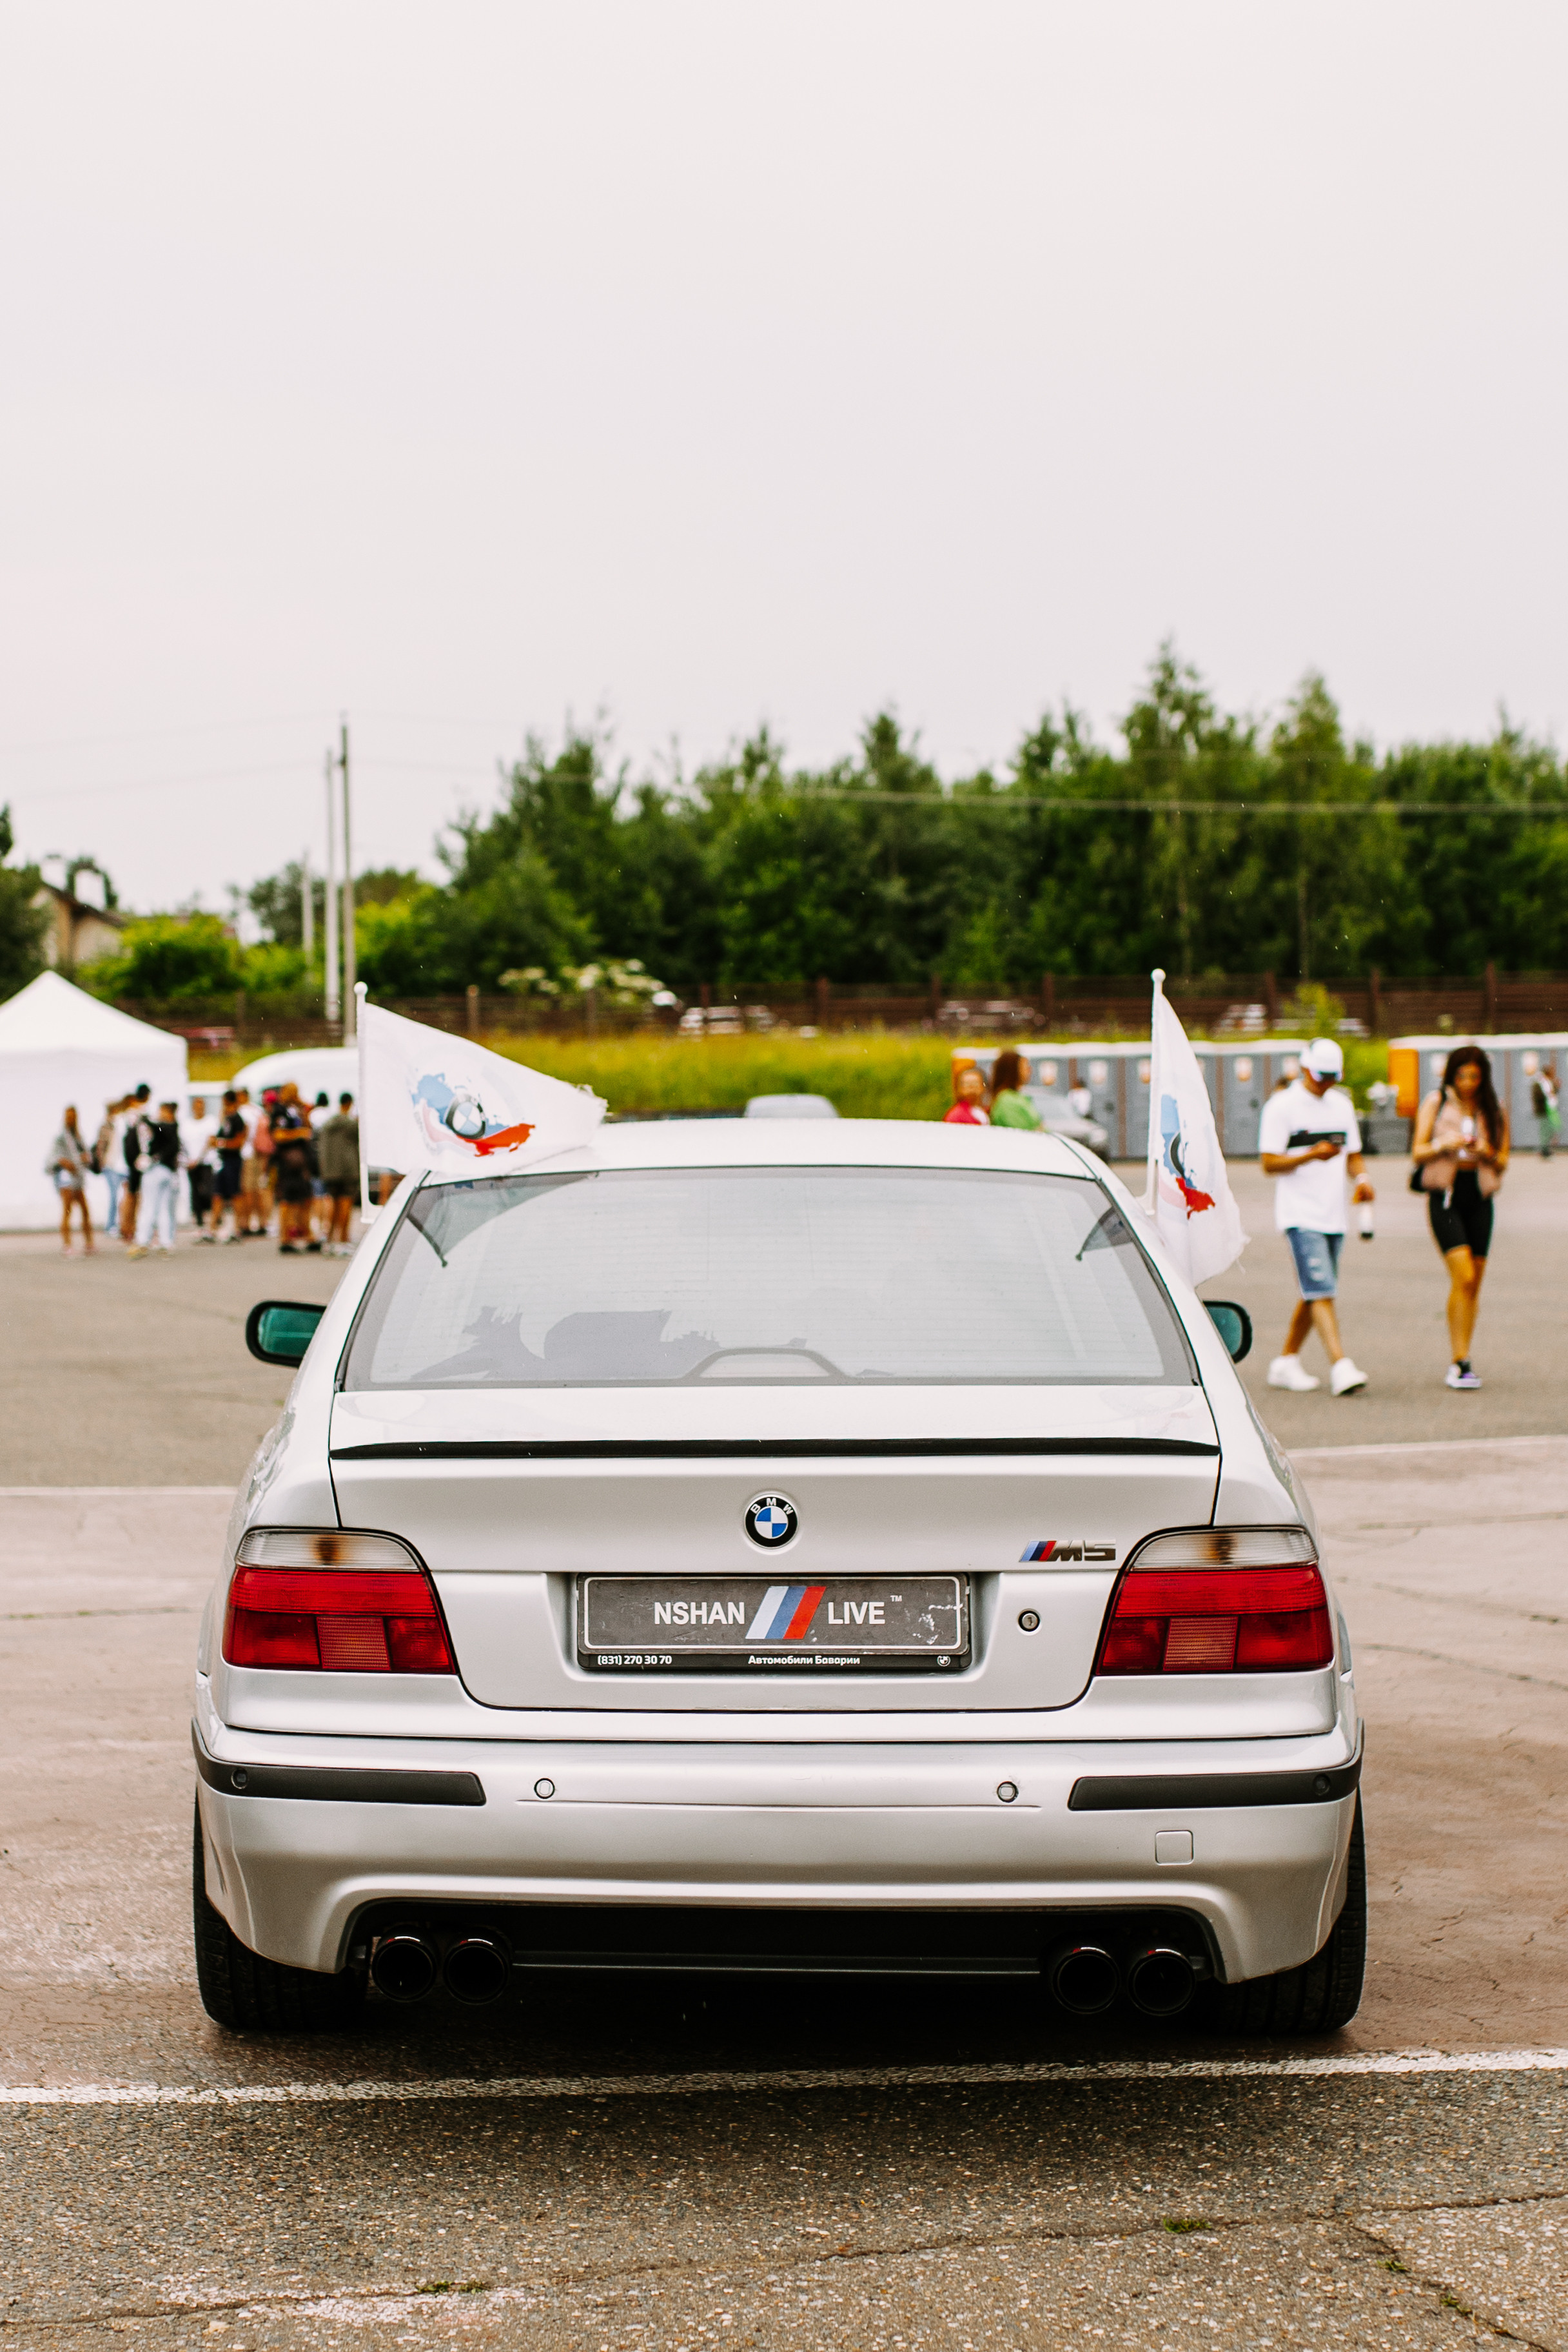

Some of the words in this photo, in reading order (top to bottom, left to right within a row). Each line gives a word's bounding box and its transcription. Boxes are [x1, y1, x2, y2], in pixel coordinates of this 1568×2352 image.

[750, 1497, 794, 1515] BMW
[1047, 1540, 1116, 1562] M5
[654, 1602, 745, 1625] NSHAN
[828, 1602, 885, 1625] LIVE
[597, 1654, 622, 1665] (831)
[623, 1655, 643, 1665] 270
[644, 1655, 658, 1665] 30
[658, 1655, 672, 1665] 70
[748, 1655, 814, 1665] Автомобили
[814, 1655, 860, 1666] Баварии
